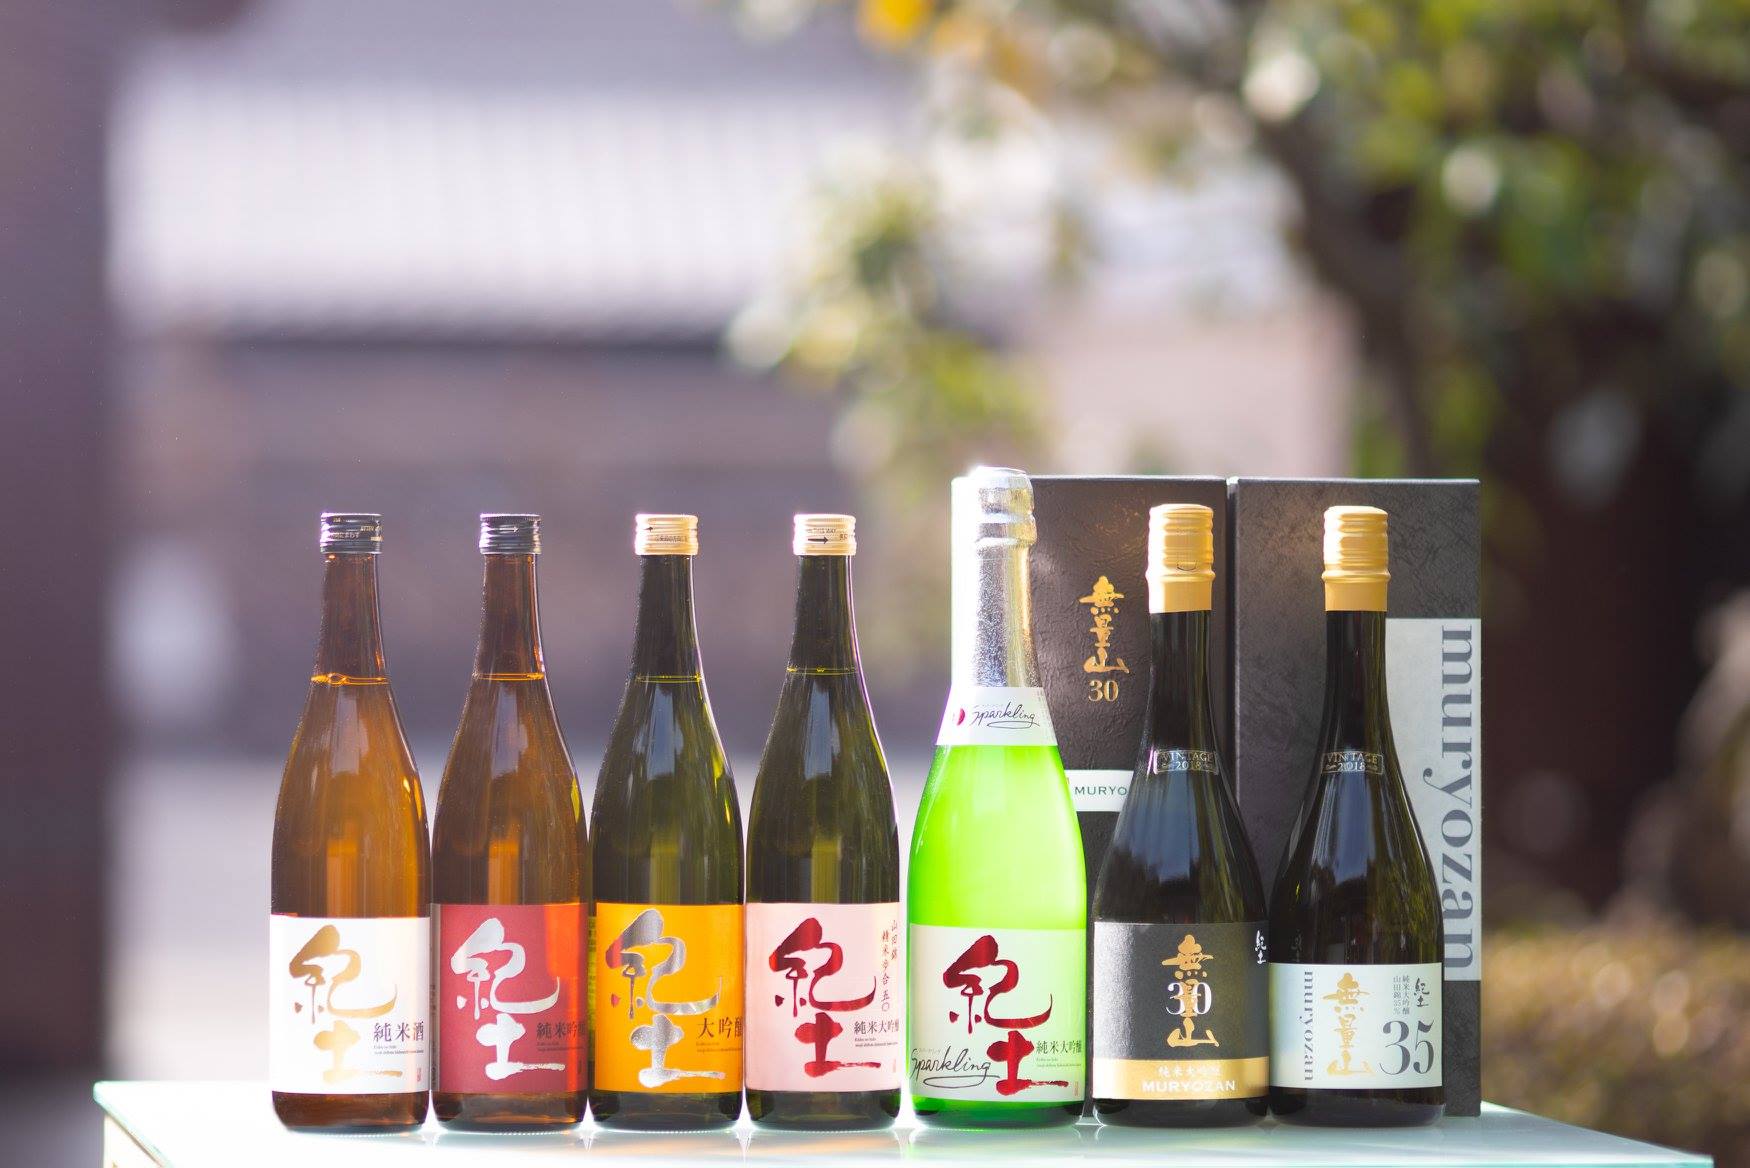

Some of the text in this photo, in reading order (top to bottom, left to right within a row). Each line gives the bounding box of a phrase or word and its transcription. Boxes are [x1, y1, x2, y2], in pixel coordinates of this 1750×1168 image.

[1088, 679, 1120, 702] 30
[1161, 751, 1214, 761] VINTAGE
[1327, 752, 1378, 764] VINTAGE
[1074, 786, 1128, 796] MURYO
[1423, 624, 1475, 971] muryozan
[1165, 981, 1212, 1015] 30
[373, 1021, 424, 1042] 純米酒
[1299, 971, 1314, 1081] muryozan
[1379, 1018, 1435, 1076] 35
[909, 1045, 1000, 1089] Sparkling
[1143, 1079, 1236, 1093] MURYOZAN
